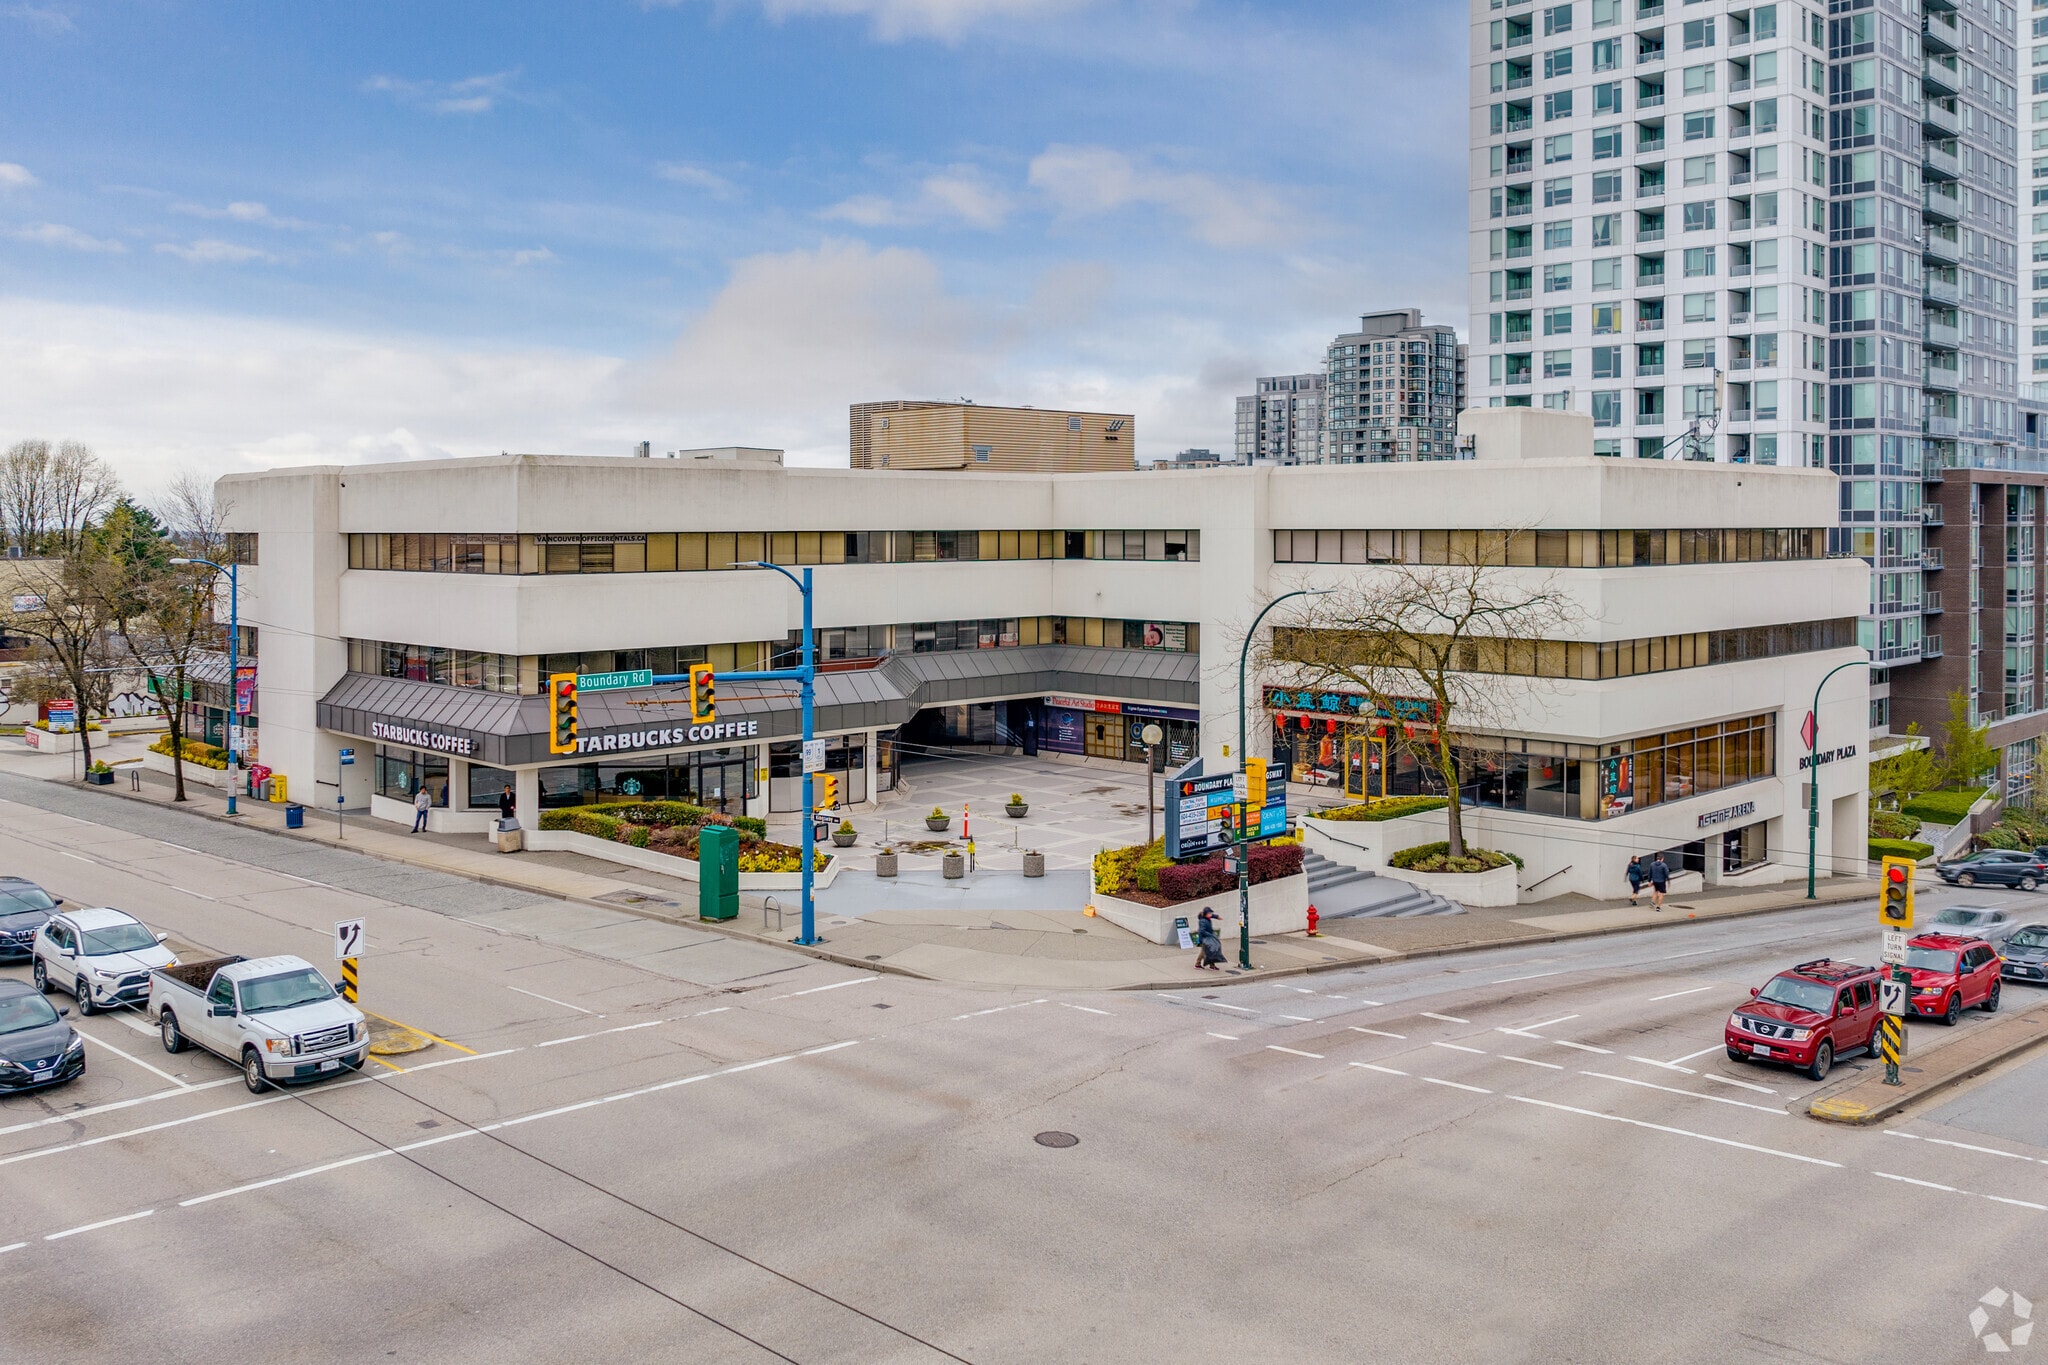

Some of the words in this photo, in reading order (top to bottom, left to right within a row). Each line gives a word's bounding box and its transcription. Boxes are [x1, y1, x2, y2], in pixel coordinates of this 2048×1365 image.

[580, 674, 628, 689] Boundary
[632, 673, 645, 684] Rd
[372, 722, 429, 747] STARBUCKS
[430, 733, 471, 754] COFFEE
[563, 728, 684, 754] TARBUCKS
[688, 720, 758, 741] COFFEE
[1836, 745, 1856, 761] PLAZA
[1266, 768, 1283, 780] GSWAY
[1194, 780, 1222, 792] BOUNDARY
[1223, 778, 1233, 788] PLA
[1887, 943, 1902, 951] TURN
[1884, 952, 1904, 960] SIGNAL
